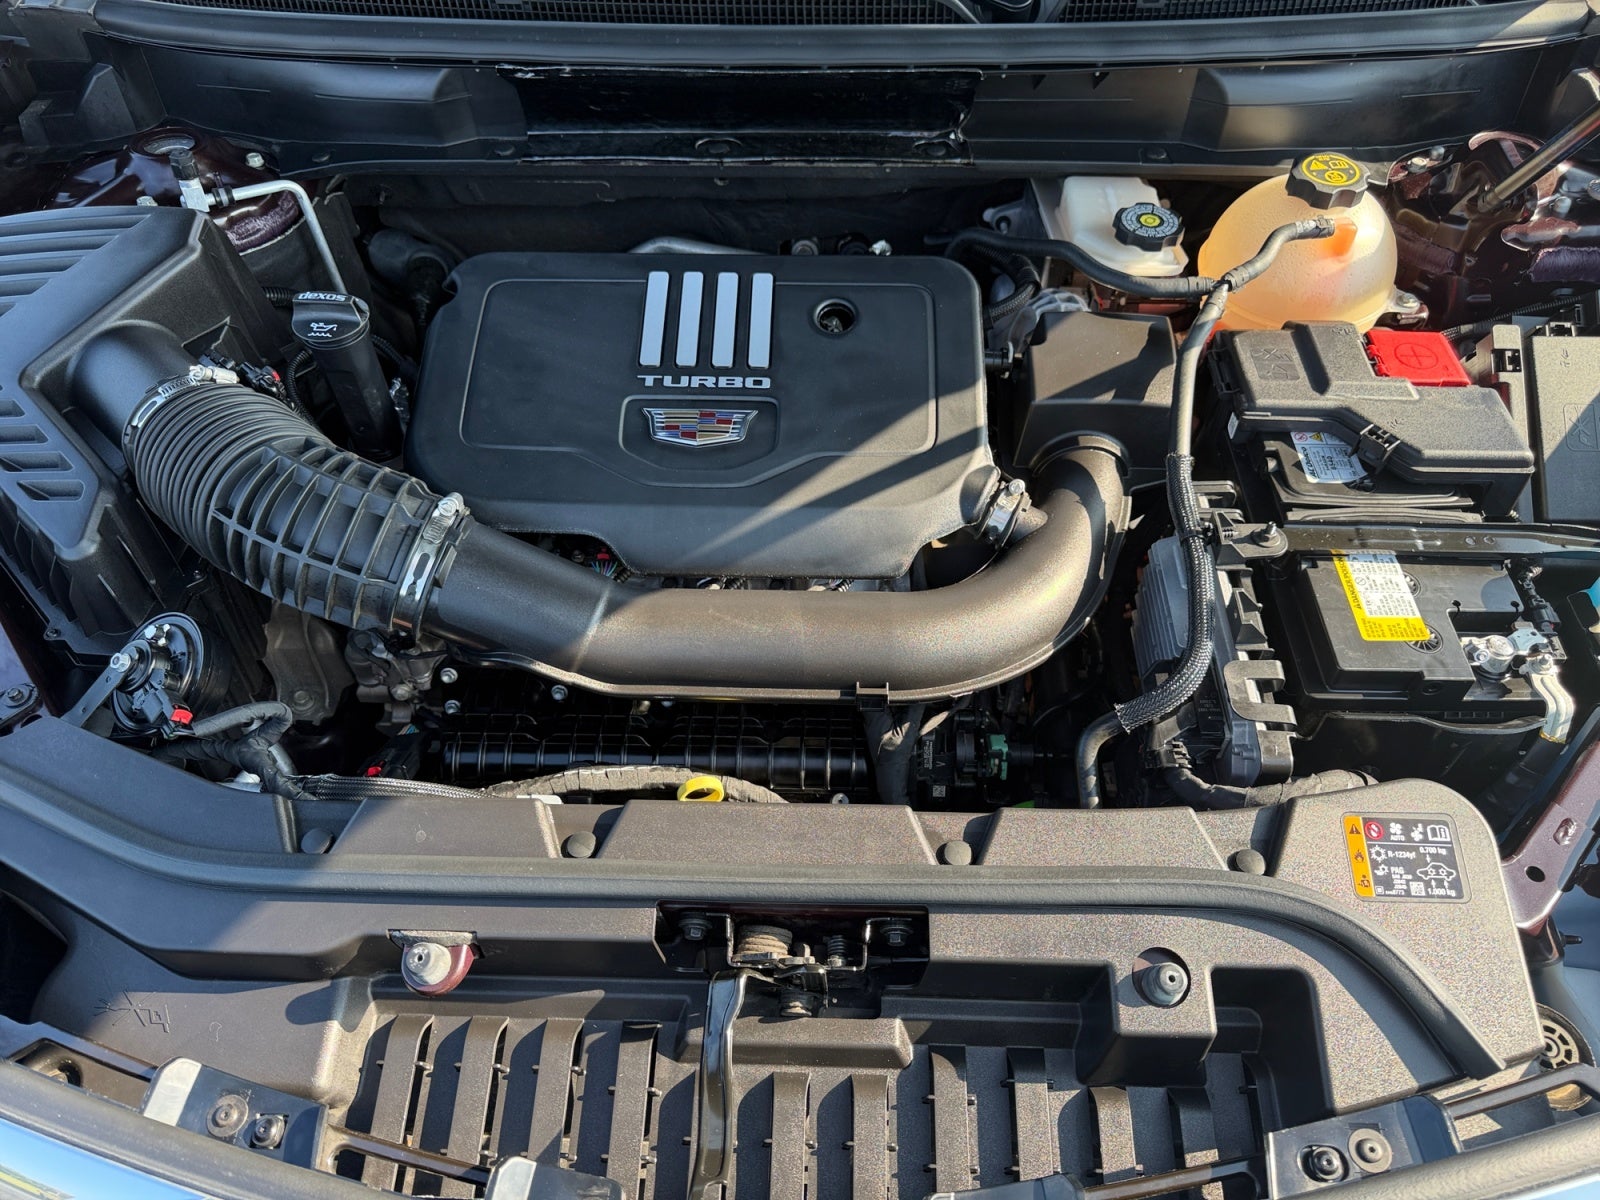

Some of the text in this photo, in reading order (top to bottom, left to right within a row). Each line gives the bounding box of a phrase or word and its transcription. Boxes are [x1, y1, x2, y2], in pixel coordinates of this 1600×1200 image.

[298, 291, 347, 302] dexos
[637, 375, 771, 389] TURBO
[1419, 846, 1447, 856] 0.700 kg
[1390, 866, 1405, 874] PAG
[1427, 887, 1456, 898] 1.000 kg
